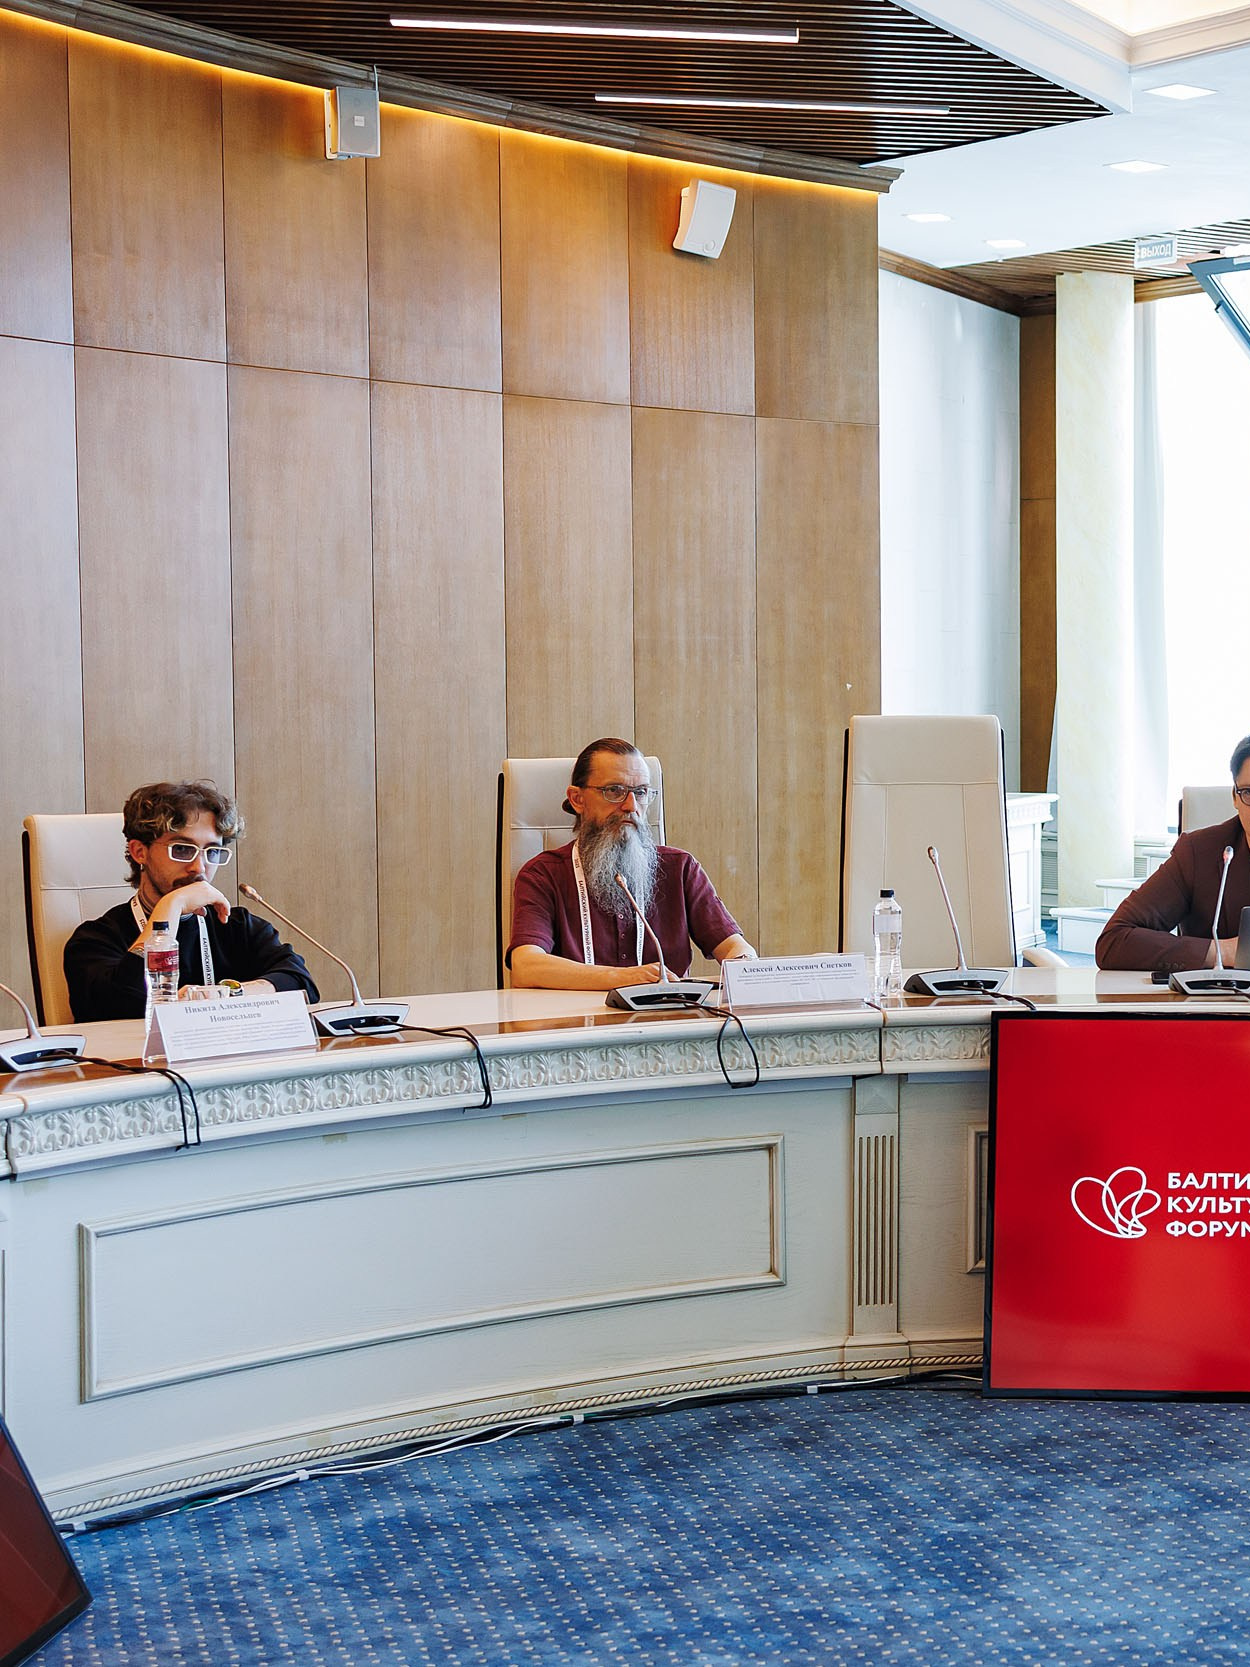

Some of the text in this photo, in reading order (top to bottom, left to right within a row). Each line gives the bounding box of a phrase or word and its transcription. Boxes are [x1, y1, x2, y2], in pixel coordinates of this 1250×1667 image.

[1140, 243, 1172, 258] ВЫХОД
[578, 880, 589, 913] БАЛТИЙСКИЙ
[583, 913, 592, 945] КУЛЬТУРНЫЙ
[742, 961, 853, 974] Алексей Алексеевич Снетков
[184, 999, 280, 1015] Никита Александрович
